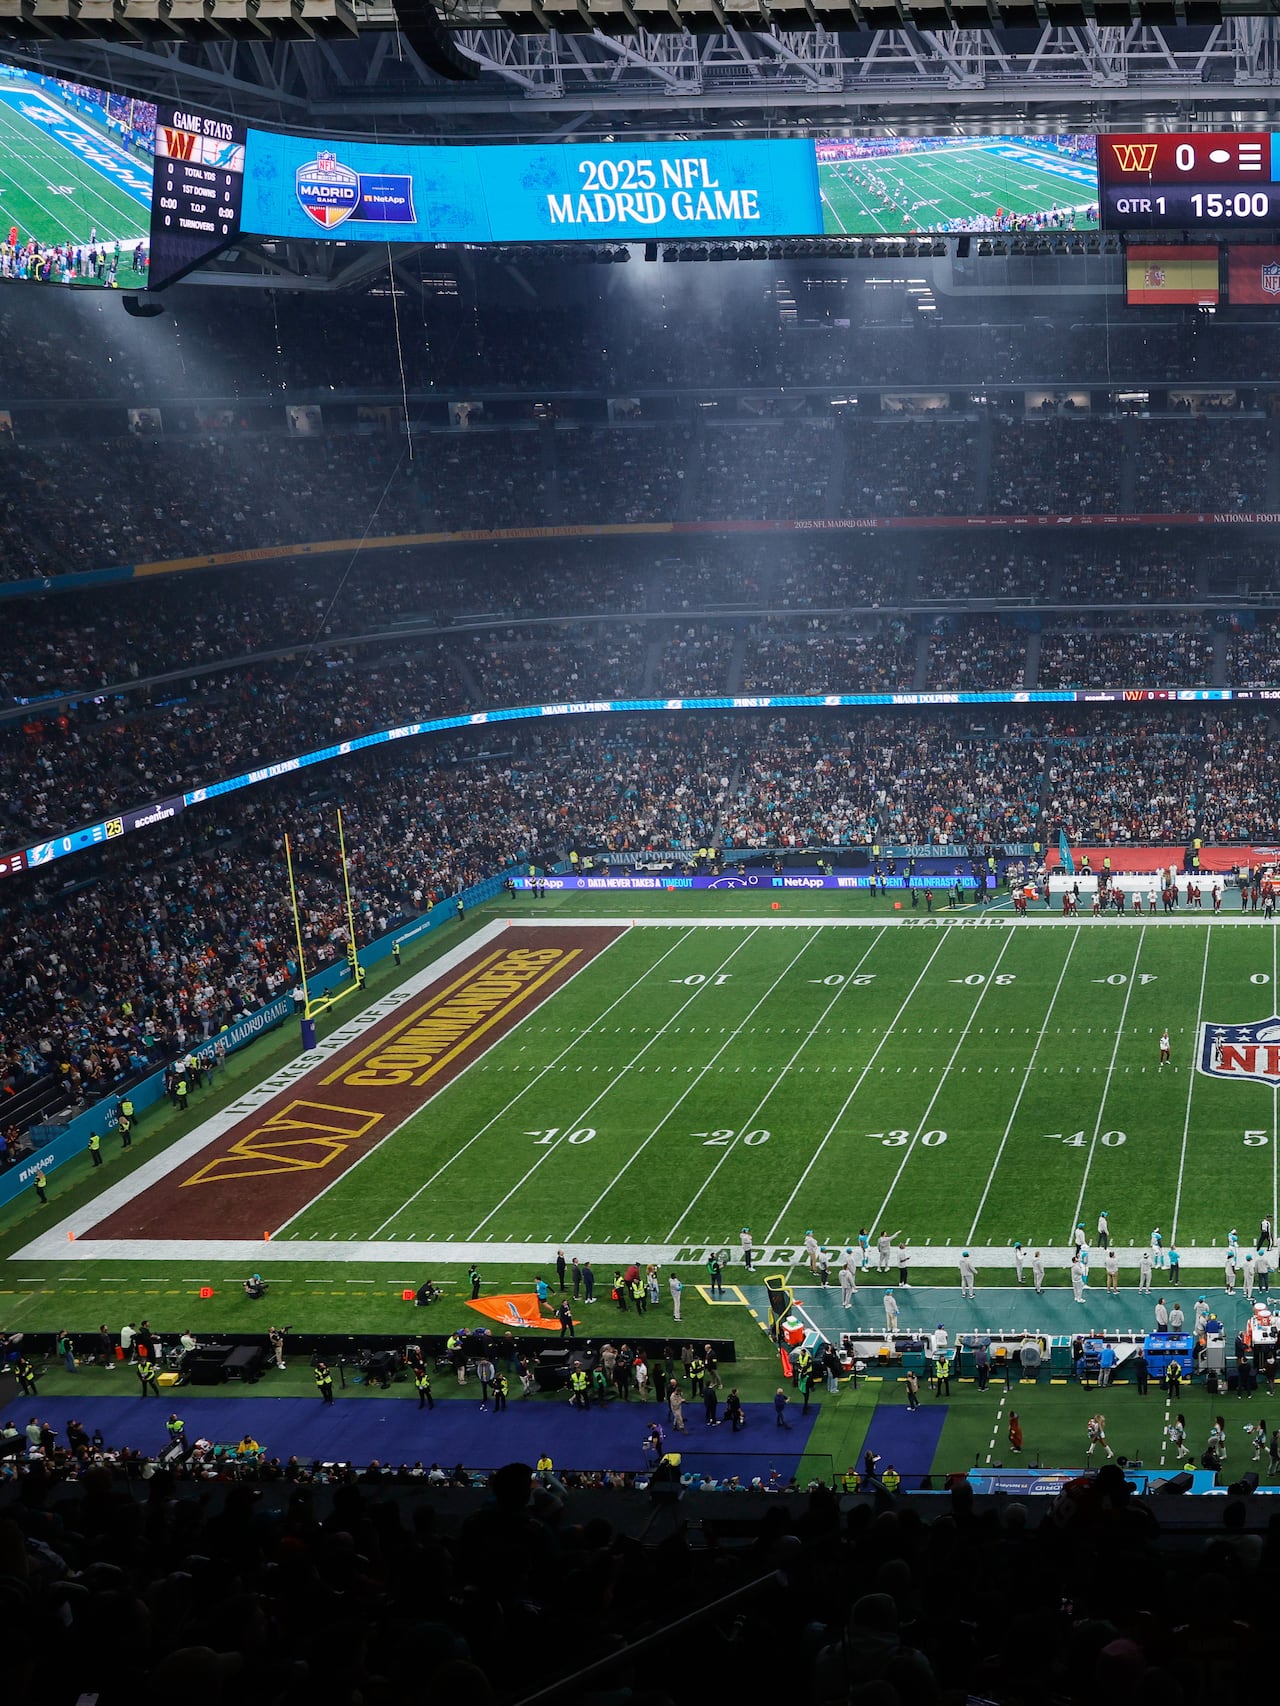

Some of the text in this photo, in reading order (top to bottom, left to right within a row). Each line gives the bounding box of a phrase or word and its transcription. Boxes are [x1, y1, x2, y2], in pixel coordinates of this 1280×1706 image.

[173, 111, 232, 140] GAME STATS
[1175, 144, 1195, 171] 0
[168, 163, 174, 174] 0
[319, 160, 334, 171] NFL
[184, 167, 216, 182] TOTAL YDS
[226, 175, 231, 185] 0
[578, 158, 719, 191] 2025 NFL
[167, 180, 173, 191] 0
[183, 184, 216, 198] 1ST DOWNS
[300, 185, 354, 198] MADRID
[160, 197, 177, 210] 0:00
[224, 192, 230, 202] 0
[373, 195, 405, 204] NetApp
[547, 190, 760, 224] MADRID GAME
[1116, 196, 1167, 214] QTR 1
[1190, 193, 1269, 218] 15:00
[218, 207, 234, 219] 0:00
[164, 215, 171, 226] 0
[179, 218, 215, 232] TURNOVERS
[222, 224, 228, 235] 0
[794, 519, 878, 529] 2025 NFL MADRID GAME
[1214, 514, 1254, 523] NATIONAL
[734, 698, 758, 707] PHINS
[892, 693, 959, 704] MIAMI DOLPHINS
[541, 702, 611, 715] MIAMI DOLPHINS
[269, 758, 299, 776] DOLPHINS
[135, 807, 174, 828] accenture
[107, 820, 121, 836] 25
[63, 838, 72, 851] 0
[905, 846, 949, 857] 2025 NFL
[588, 878, 693, 888] DATA NEVER TAKES A TIMEOUT
[784, 877, 824, 889] NetApp
[838, 877, 857, 886] WITH
[231, 1000, 288, 1044] MADRID GAME
[343, 948, 564, 1087] COMMANDERS
[225, 992, 411, 1114] IT TAKES ALL OF US
[531, 1128, 596, 1144] 10
[702, 1129, 771, 1146] 20
[881, 1129, 947, 1146] 30
[1061, 1130, 1128, 1147] 40
[27, 1154, 55, 1178] NetApp
